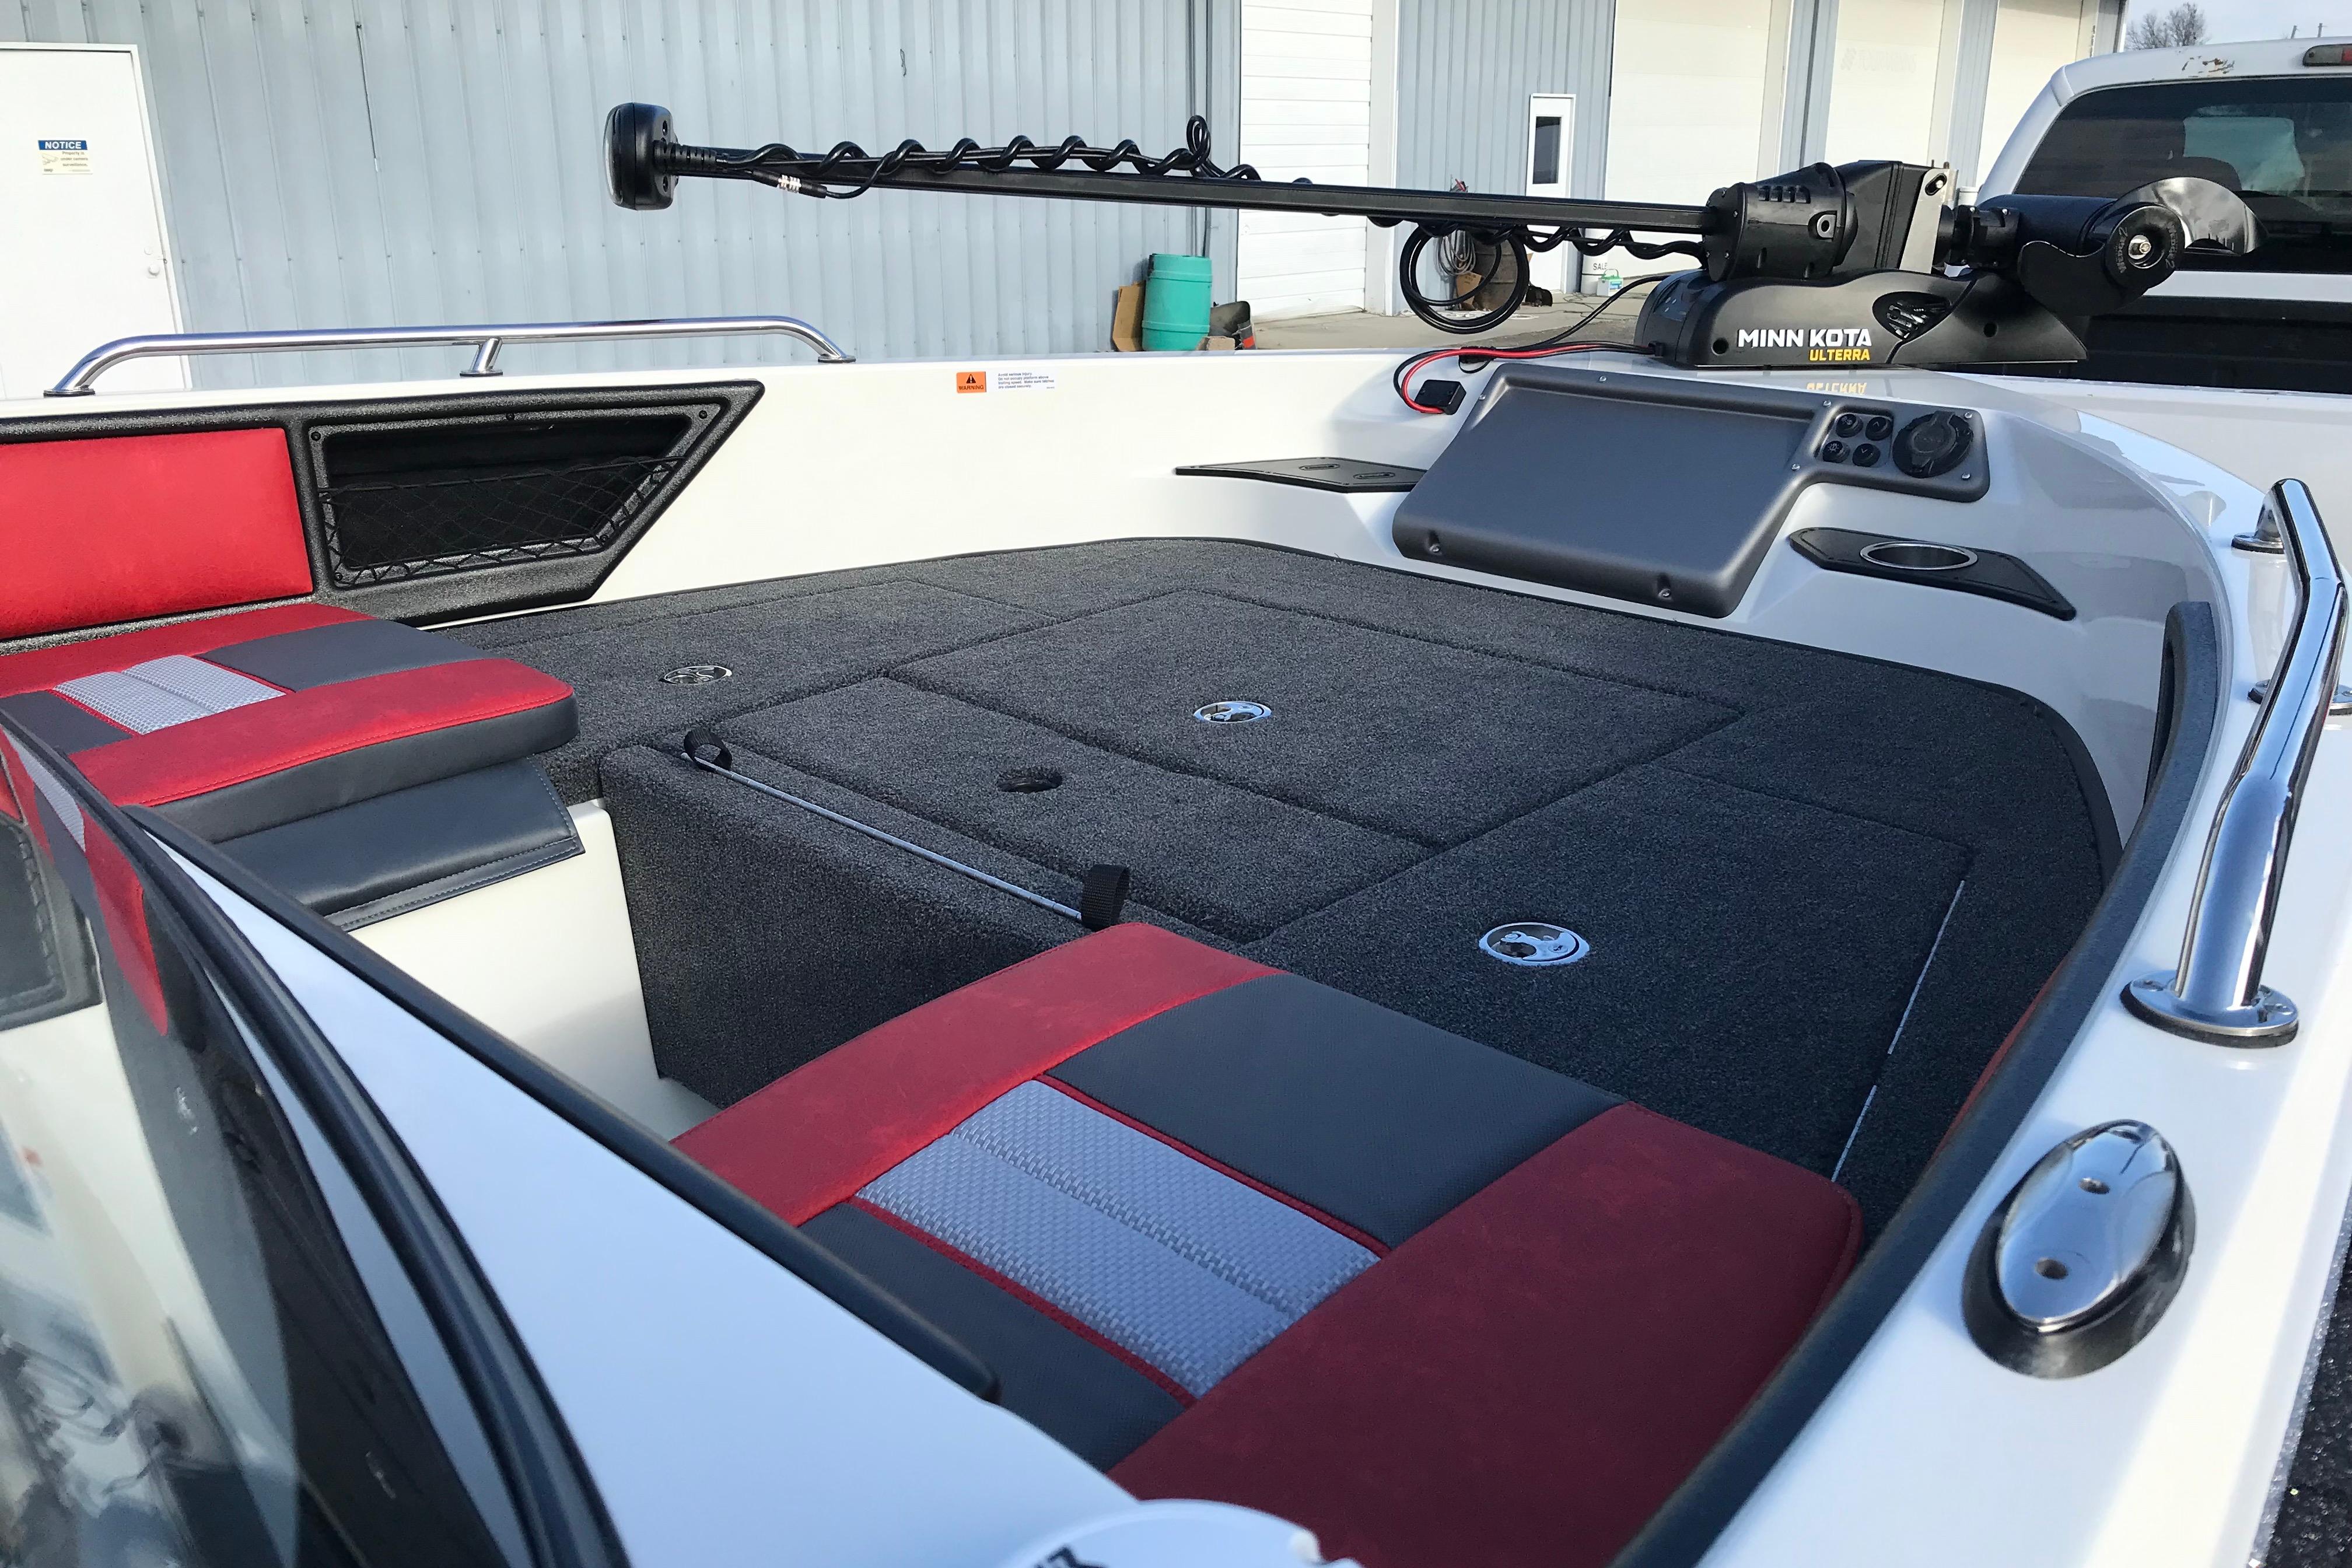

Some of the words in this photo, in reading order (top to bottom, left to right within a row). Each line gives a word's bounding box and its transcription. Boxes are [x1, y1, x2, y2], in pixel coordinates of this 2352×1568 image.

[45, 141, 81, 149] NOTICE
[1738, 329, 1804, 347] MINN
[1809, 328, 1872, 347] KOTA
[1810, 349, 1870, 361] ULTERRA
